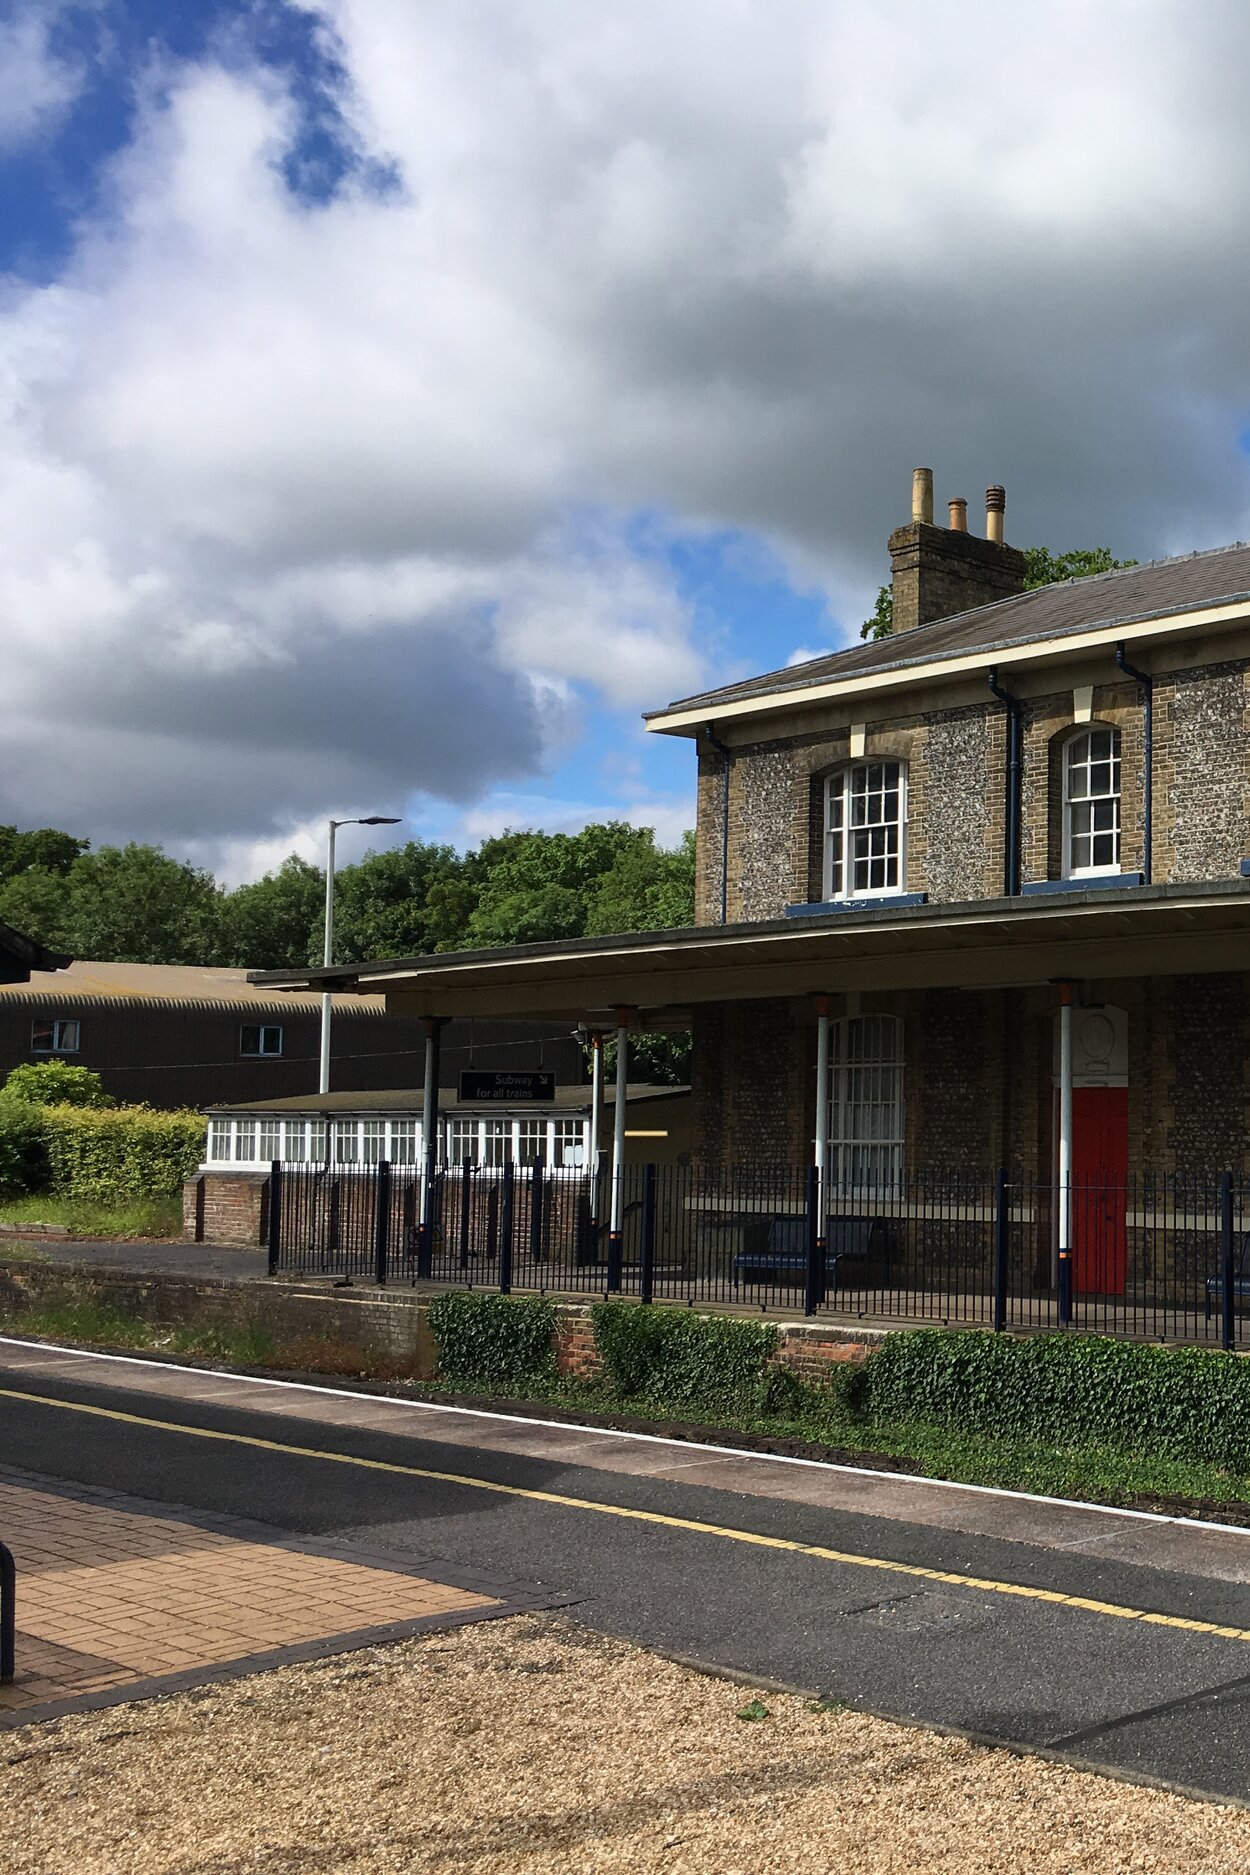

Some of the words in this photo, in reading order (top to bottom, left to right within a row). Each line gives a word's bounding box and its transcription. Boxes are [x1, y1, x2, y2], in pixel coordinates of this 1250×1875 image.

[495, 1074, 533, 1087] Subway
[476, 1087, 492, 1098] for
[492, 1087, 504, 1098] all
[505, 1087, 534, 1098] trains
